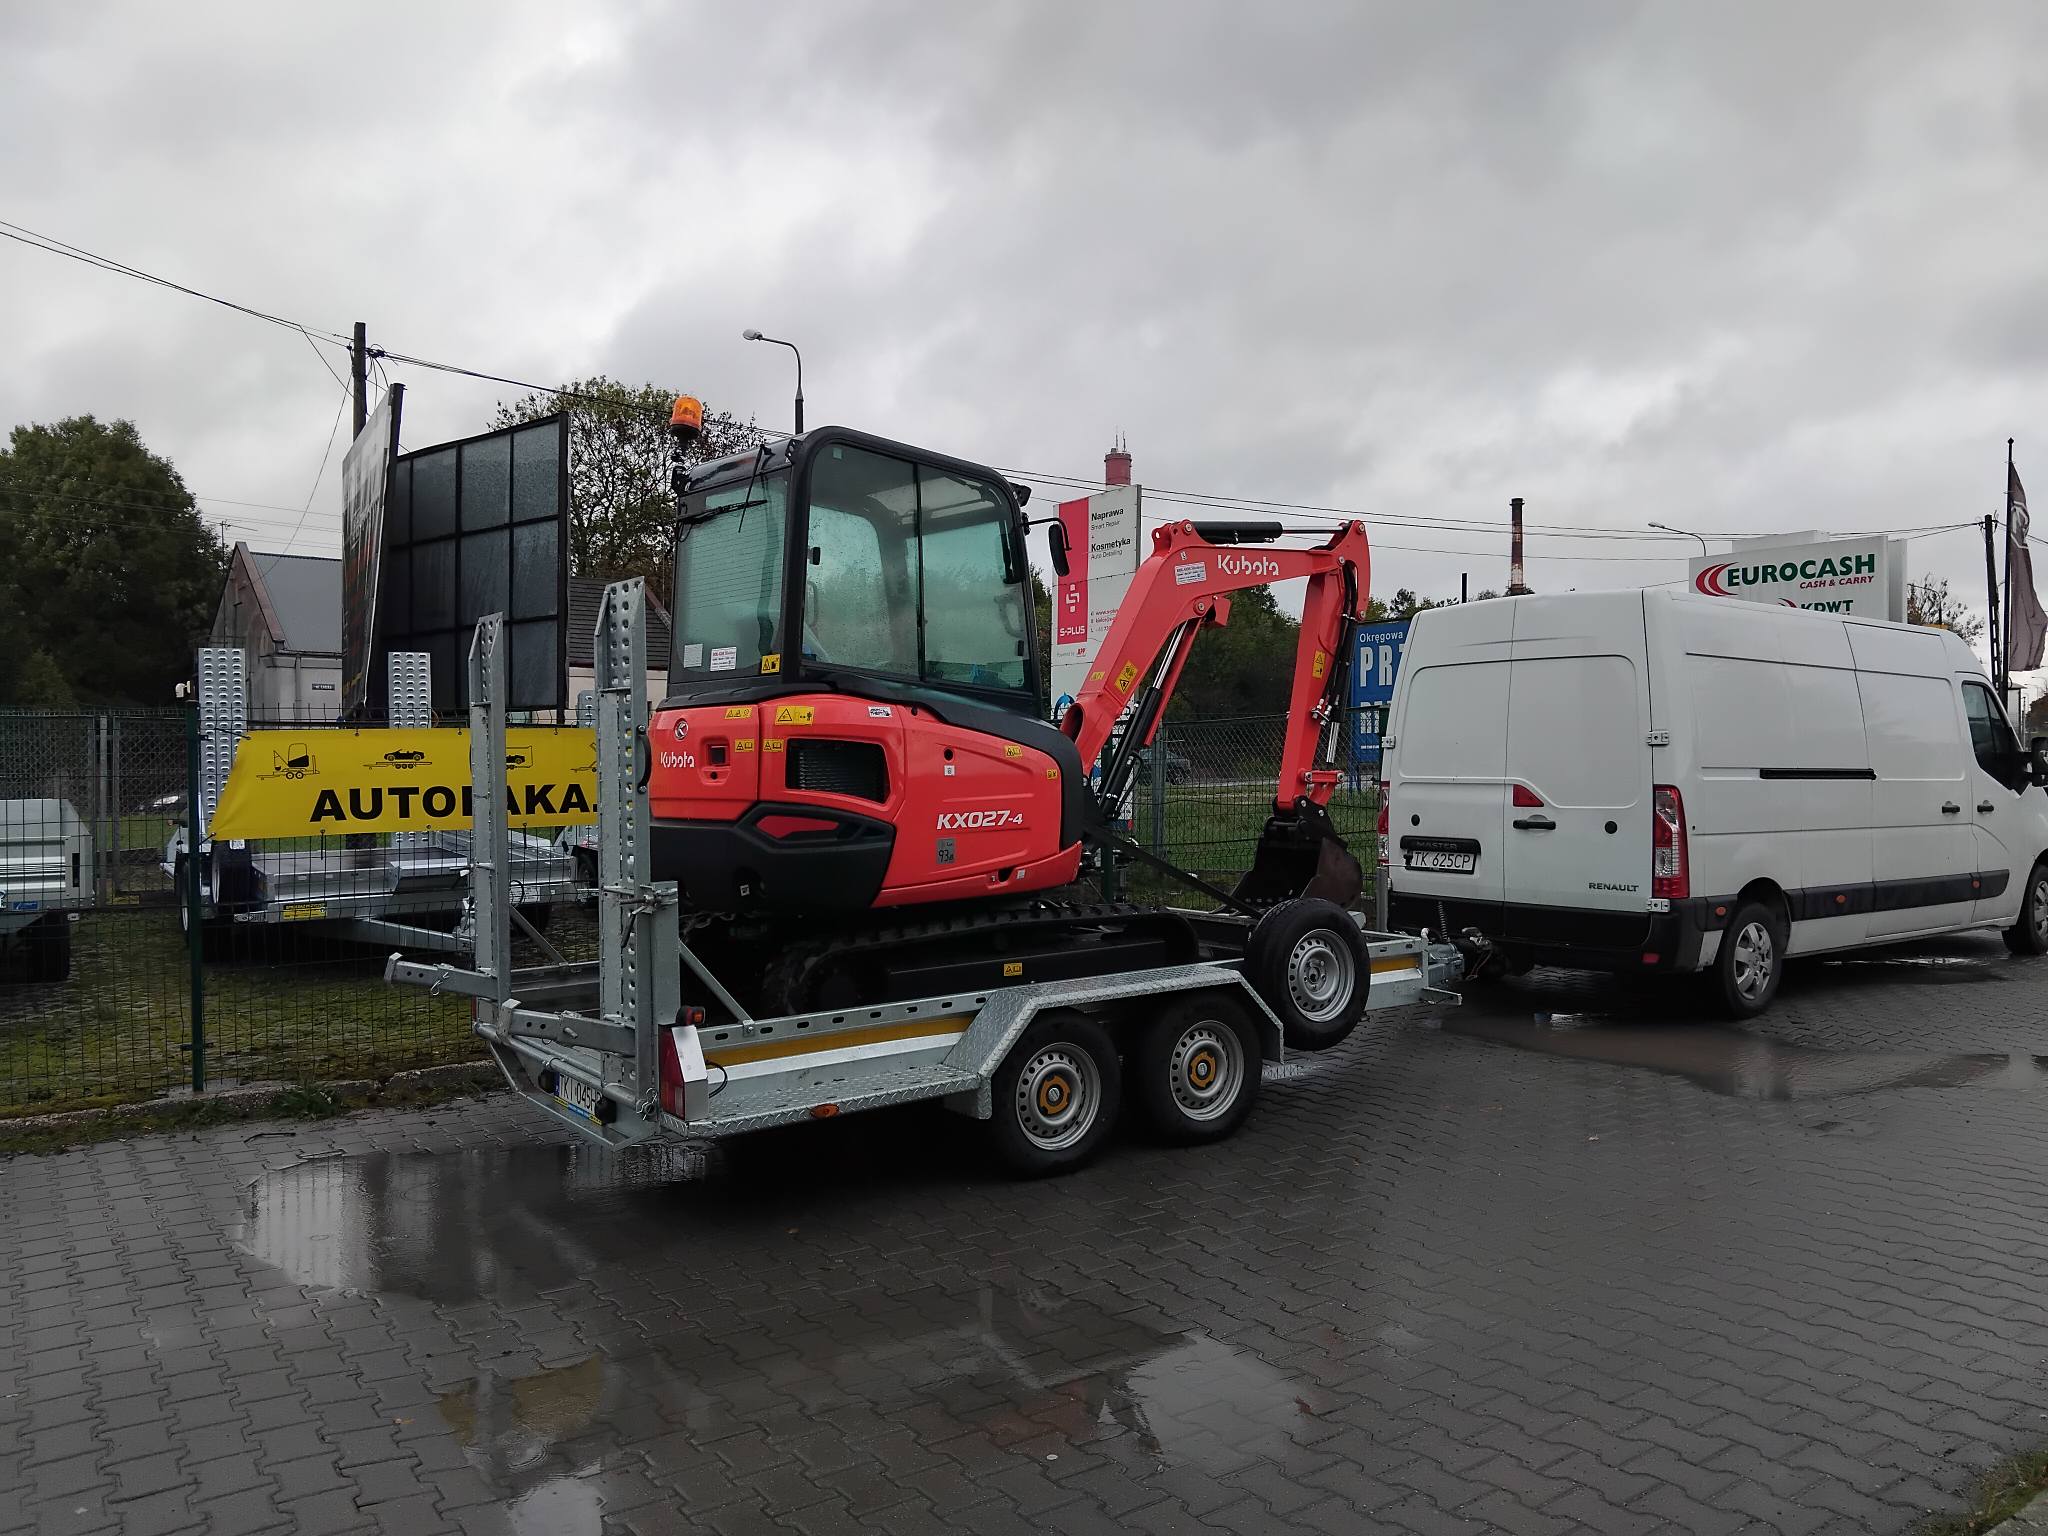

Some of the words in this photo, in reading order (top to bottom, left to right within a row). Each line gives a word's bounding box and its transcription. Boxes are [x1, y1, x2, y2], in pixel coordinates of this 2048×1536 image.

[1091, 508, 1124, 521] Naprawa
[1091, 538, 1131, 552] Kosmetyka
[1217, 554, 1280, 576] Kubota
[1727, 553, 1875, 587] EUROCASH
[1799, 580, 1827, 589] CASH
[1828, 578, 1836, 587] &
[1838, 575, 1874, 586] CARRY
[1359, 631, 1404, 643] Okręgowa
[1360, 643, 1405, 687] PR
[660, 751, 695, 768] Kubota
[936, 810, 1023, 830] KX027-4
[1415, 851, 1430, 866] TK
[1432, 852, 1471, 869] 625CP
[1588, 882, 1640, 892] RENAULT
